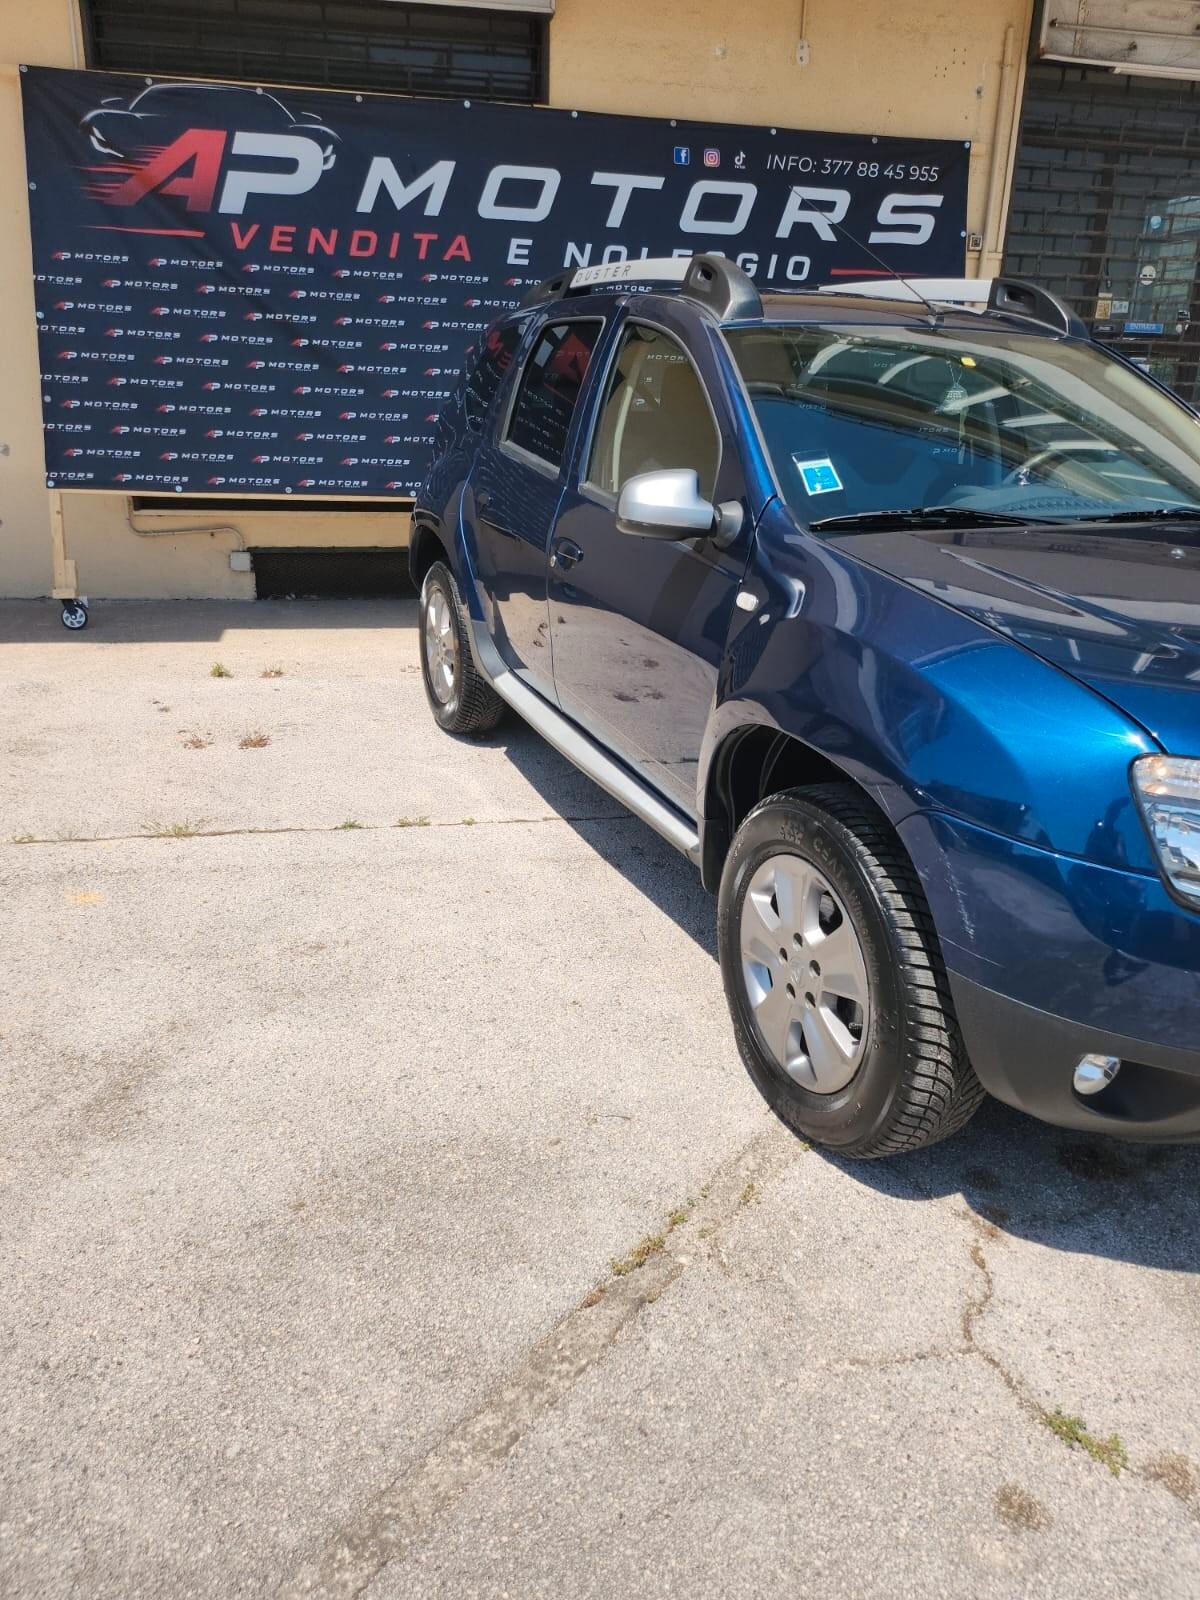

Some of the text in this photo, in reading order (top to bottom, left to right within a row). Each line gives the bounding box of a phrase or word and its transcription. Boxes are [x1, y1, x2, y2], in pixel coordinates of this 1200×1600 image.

[766, 154, 940, 182] INFO: 377 88 45 955
[92, 128, 945, 247] AP MOTORS
[229, 221, 812, 282] VENDITA E NOGIO
[75, 253, 129, 261] MOTORS
[264, 265, 314, 273] MOTORS
[575, 264, 632, 283] DUSTER
[125, 281, 178, 290] MOTORS
[218, 286, 270, 294] MOTORS
[78, 303, 132, 311] MOTORS
[173, 309, 226, 317] MOTORS
[355, 318, 405, 326] MOTORS
[128, 330, 180, 338] MOTORS
[221, 335, 273, 343] MOTORS
[81, 352, 135, 360] MOTORS
[176, 357, 229, 365] MOTORS
[269, 361, 319, 369] MOTORS
[358, 366, 406, 374] MOTORS
[130, 379, 184, 387] MOTORS
[224, 383, 275, 391] MOTORS
[315, 387, 365, 395] MOTORS
[84, 401, 138, 409] MOTORS
[133, 427, 186, 435] MOTORS
